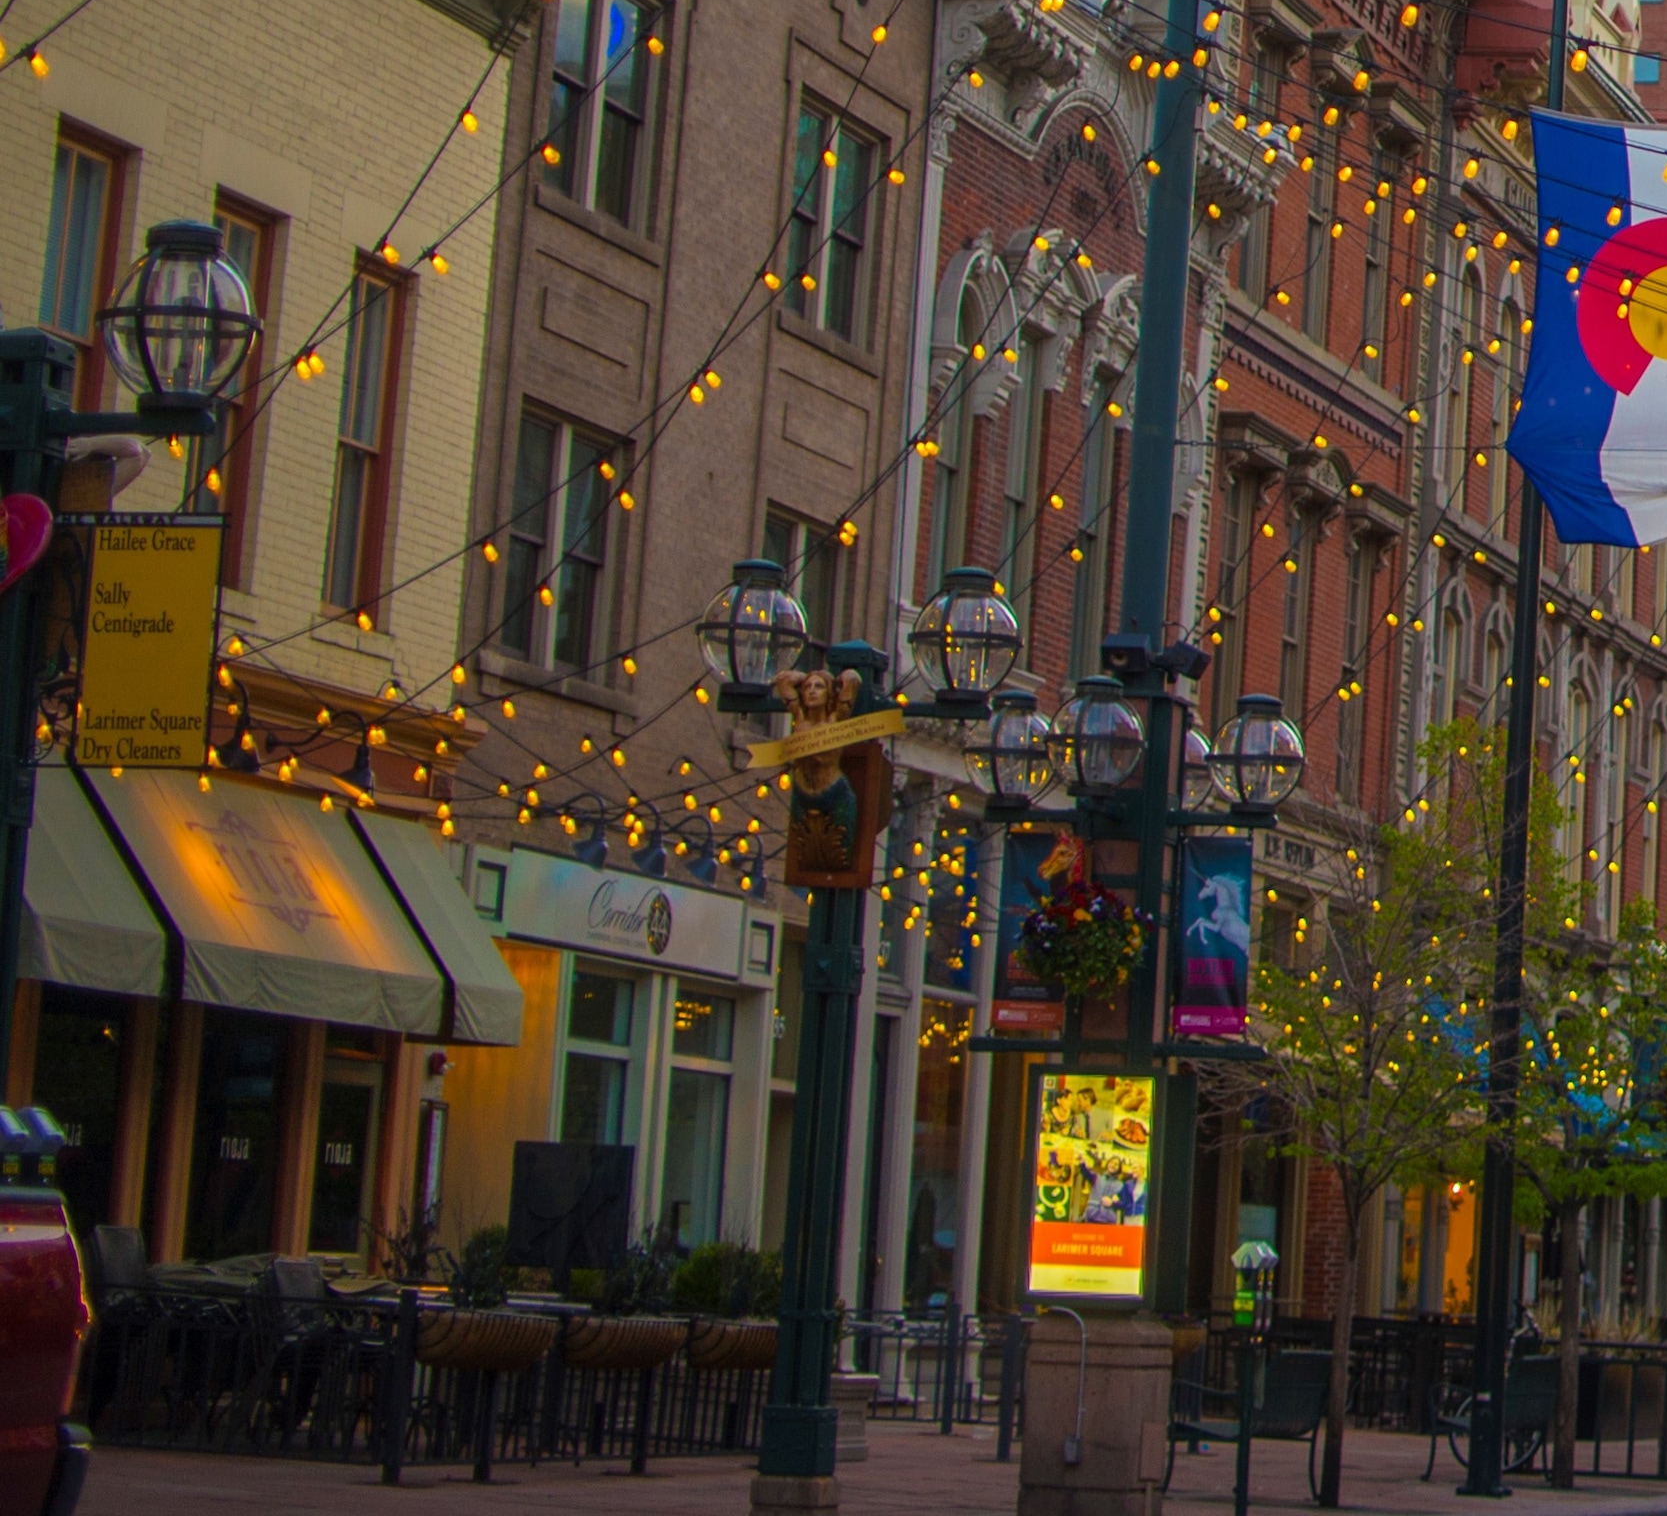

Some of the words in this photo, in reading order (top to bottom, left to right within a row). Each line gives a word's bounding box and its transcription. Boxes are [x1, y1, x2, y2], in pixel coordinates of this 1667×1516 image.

[98, 529, 148, 551] Hailee
[151, 529, 196, 551] Grace
[94, 582, 131, 609] Sally
[92, 611, 175, 638] Centigrade
[85, 708, 146, 731] Larimer
[150, 708, 202, 734] Square
[82, 737, 112, 763] Dry
[116, 737, 182, 760] Cleaners
[588, 879, 663, 933] Corridor
[220, 1137, 249, 1160] rioja
[325, 1142, 352, 1165] rioja
[1052, 1243, 1088, 1255] LARIMER
[1090, 1245, 1123, 1257] SQUARE
